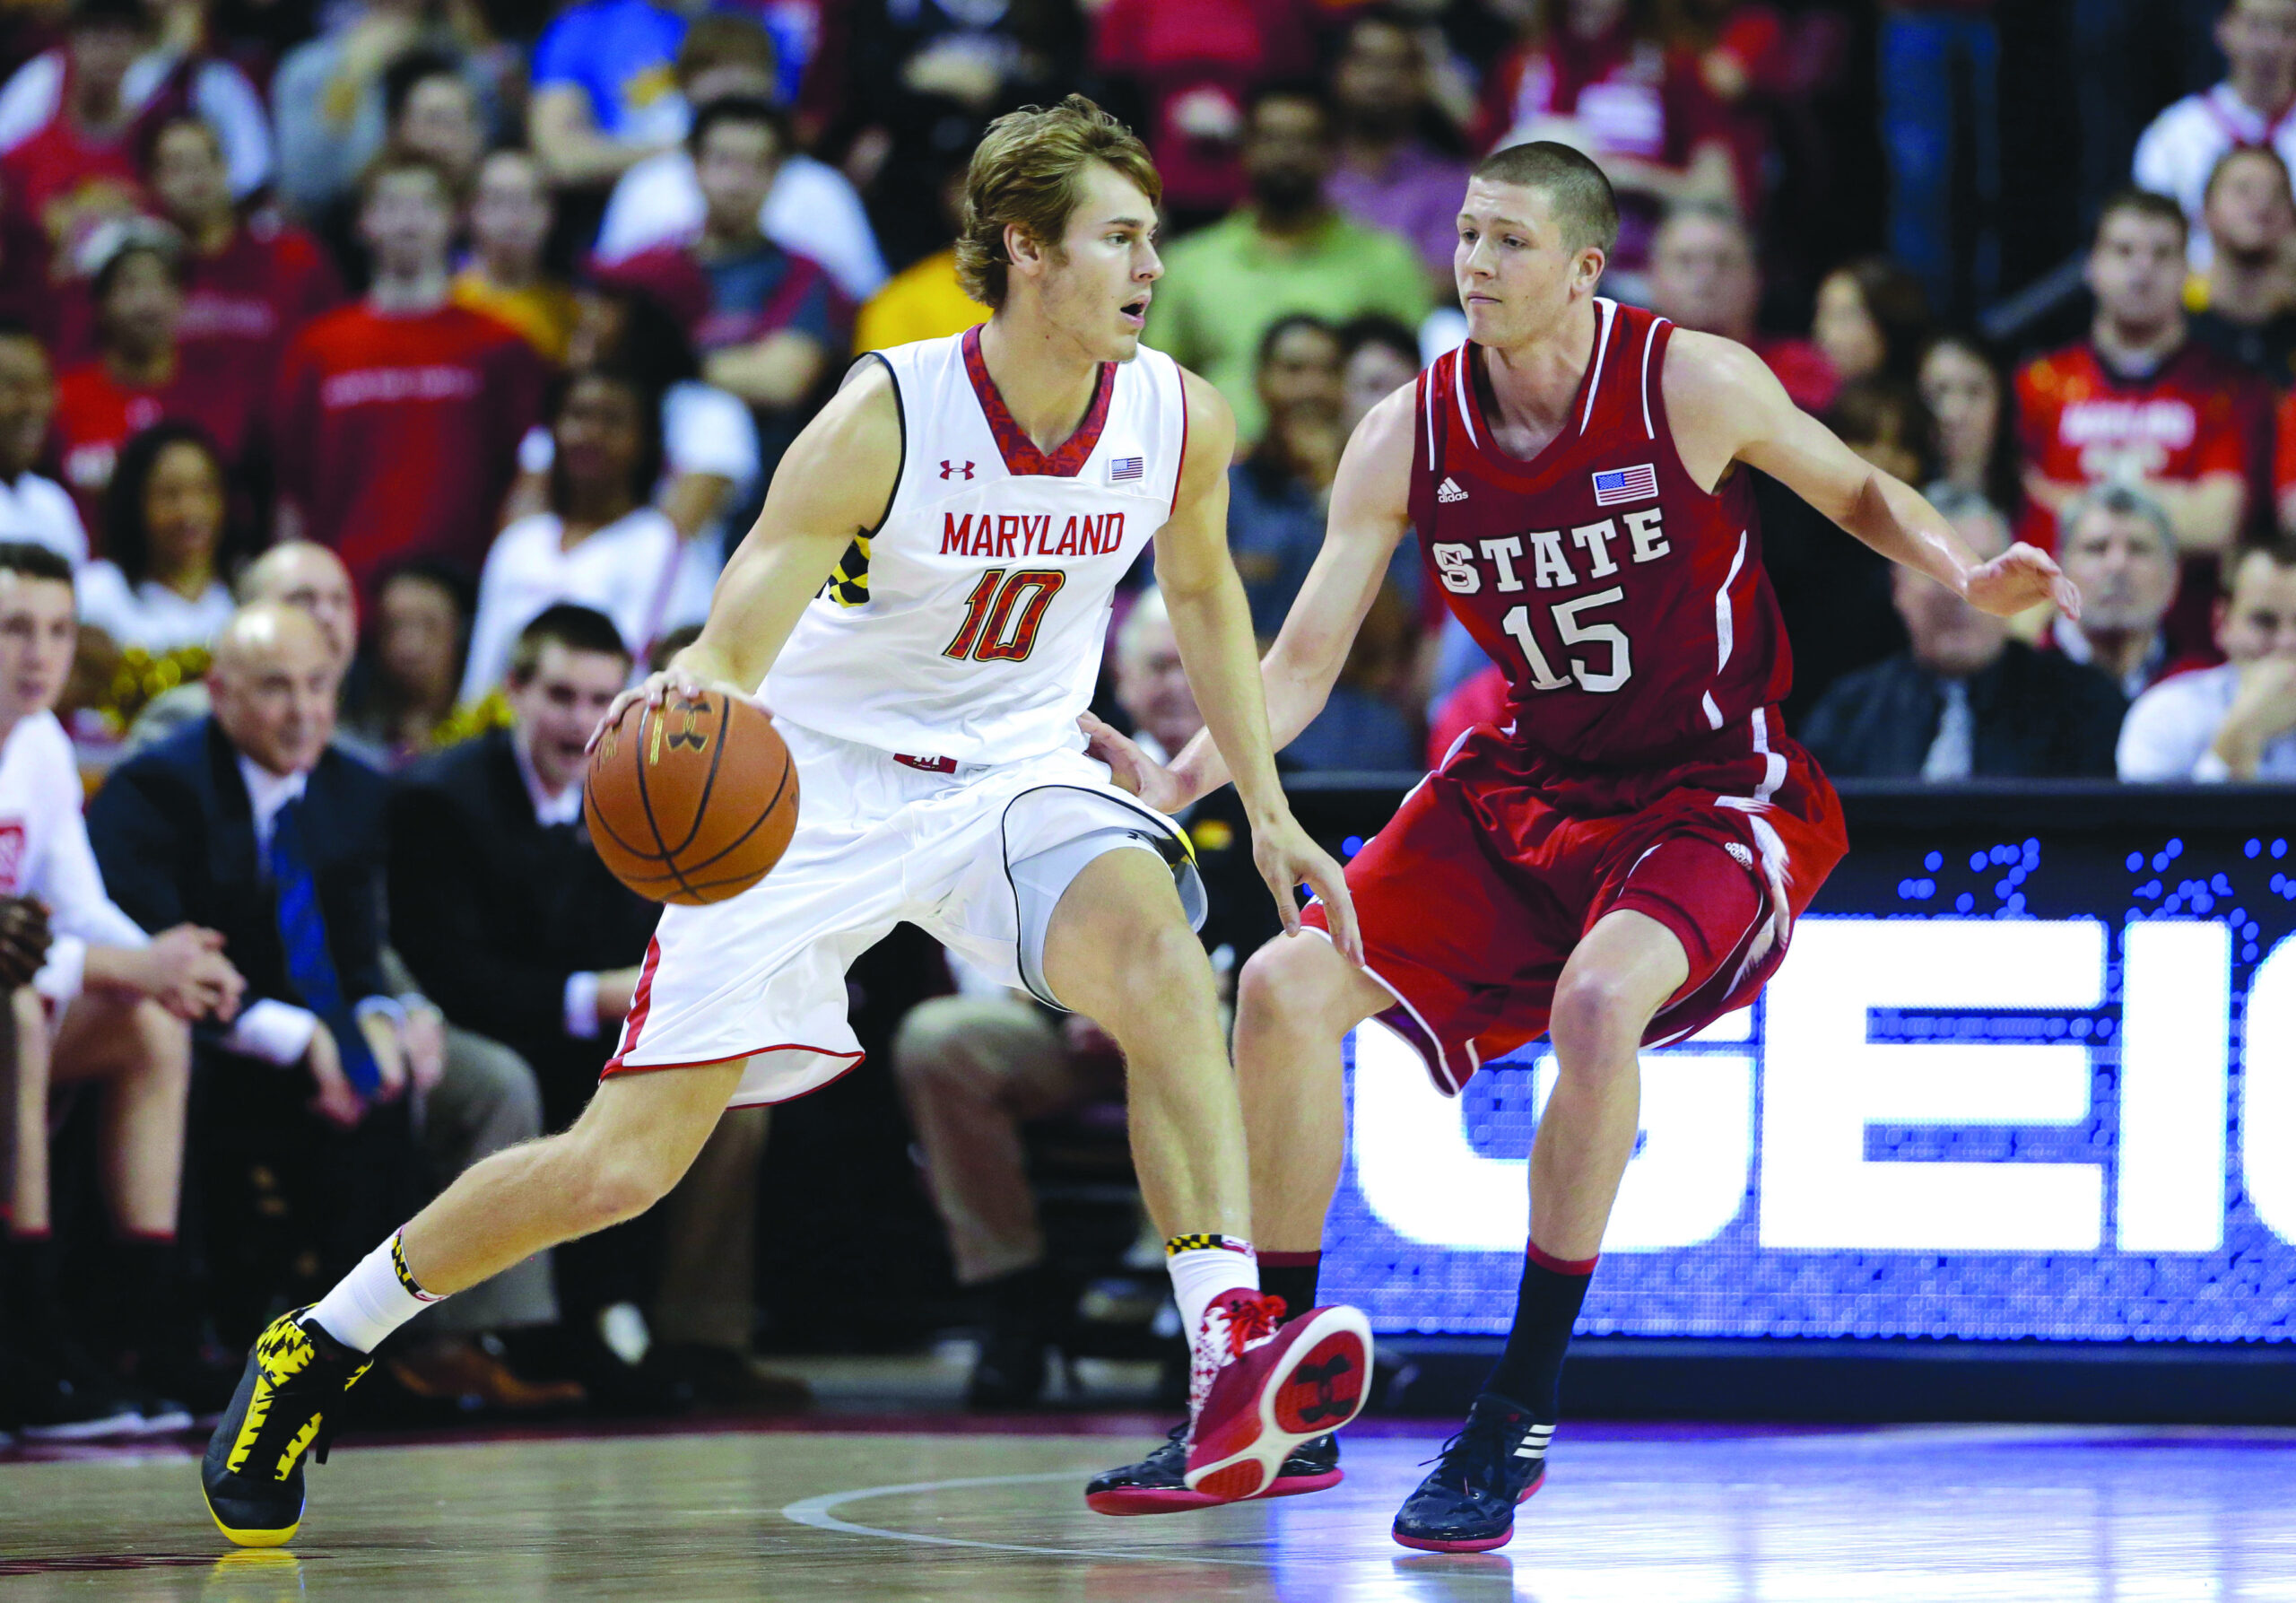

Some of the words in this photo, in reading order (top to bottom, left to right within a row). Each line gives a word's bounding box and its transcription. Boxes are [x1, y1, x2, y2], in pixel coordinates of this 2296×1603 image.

[938, 511, 1126, 558] MARYLAND
[1438, 491, 1469, 503] adidas
[1431, 506, 1672, 595] STATE
[941, 568, 1067, 662] 10
[1501, 585, 1632, 693] 15
[1352, 918, 2296, 1253] GEI
